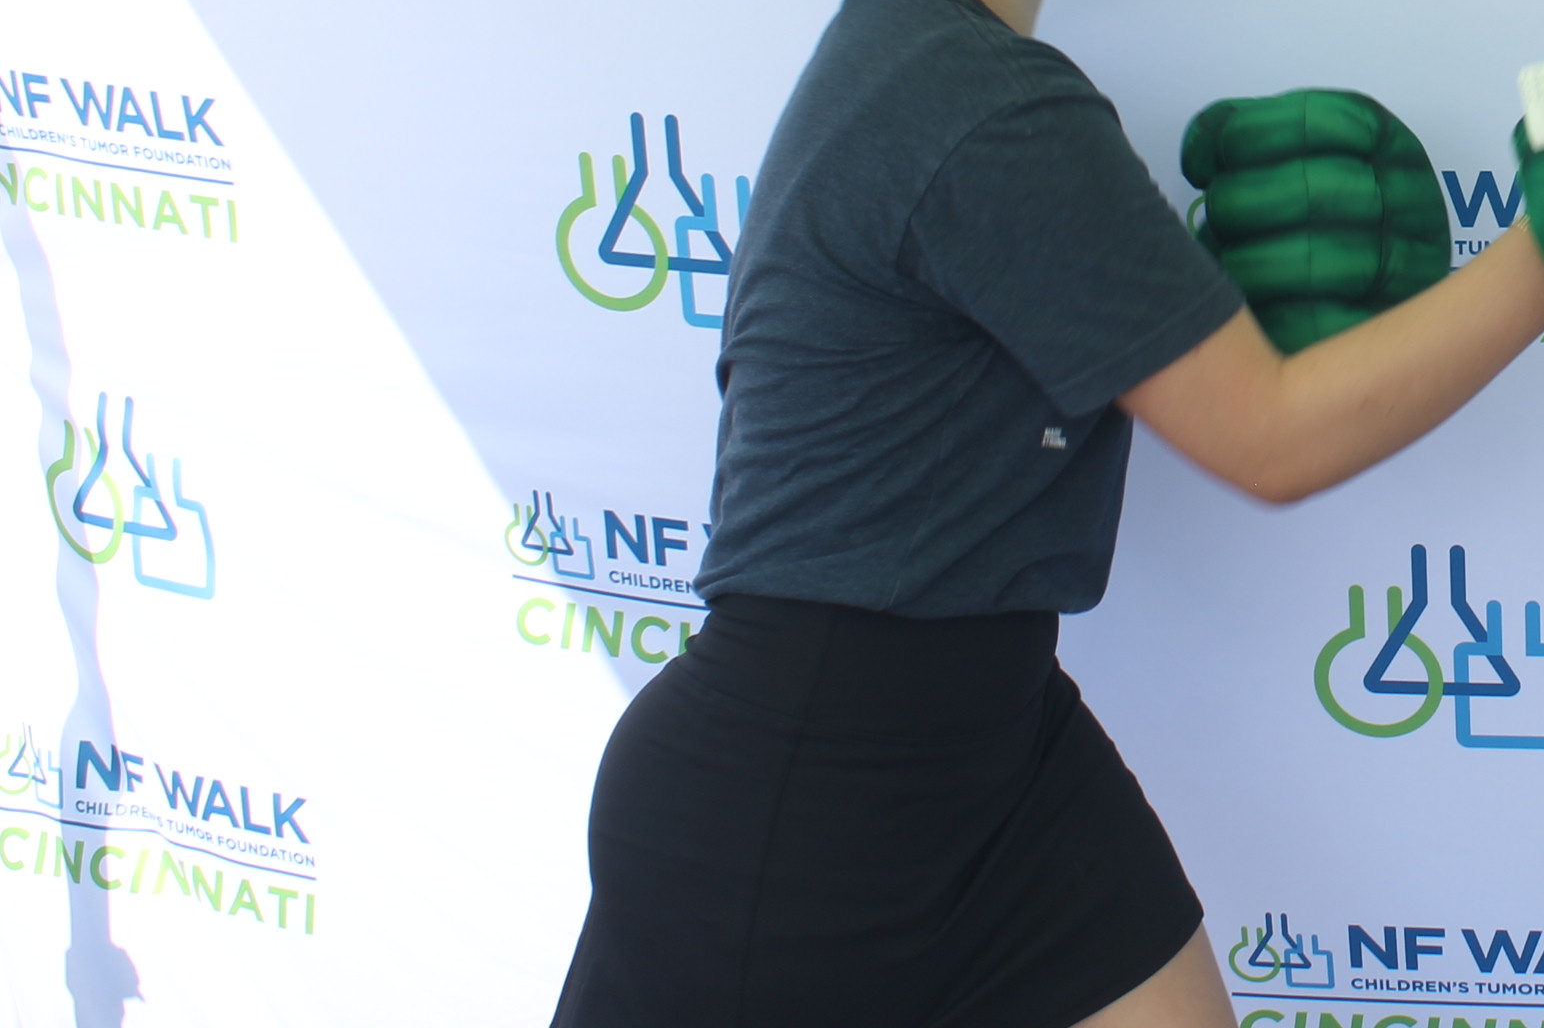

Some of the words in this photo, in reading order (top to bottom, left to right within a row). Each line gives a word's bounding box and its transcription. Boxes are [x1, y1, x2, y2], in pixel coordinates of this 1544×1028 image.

[59, 77, 225, 147] WALK
[80, 137, 129, 157] TUMOR
[134, 146, 232, 172] FOUNDATION
[603, 509, 689, 567] NF
[75, 740, 144, 793] NF
[153, 761, 311, 845] WALK
[167, 819, 214, 844] TUMOR
[217, 835, 316, 868] FOUNDATION
[0, 827, 316, 936] CINCINNATI
[1347, 924, 1446, 971] NF
[1350, 977, 1470, 995] CHILDREN'S
